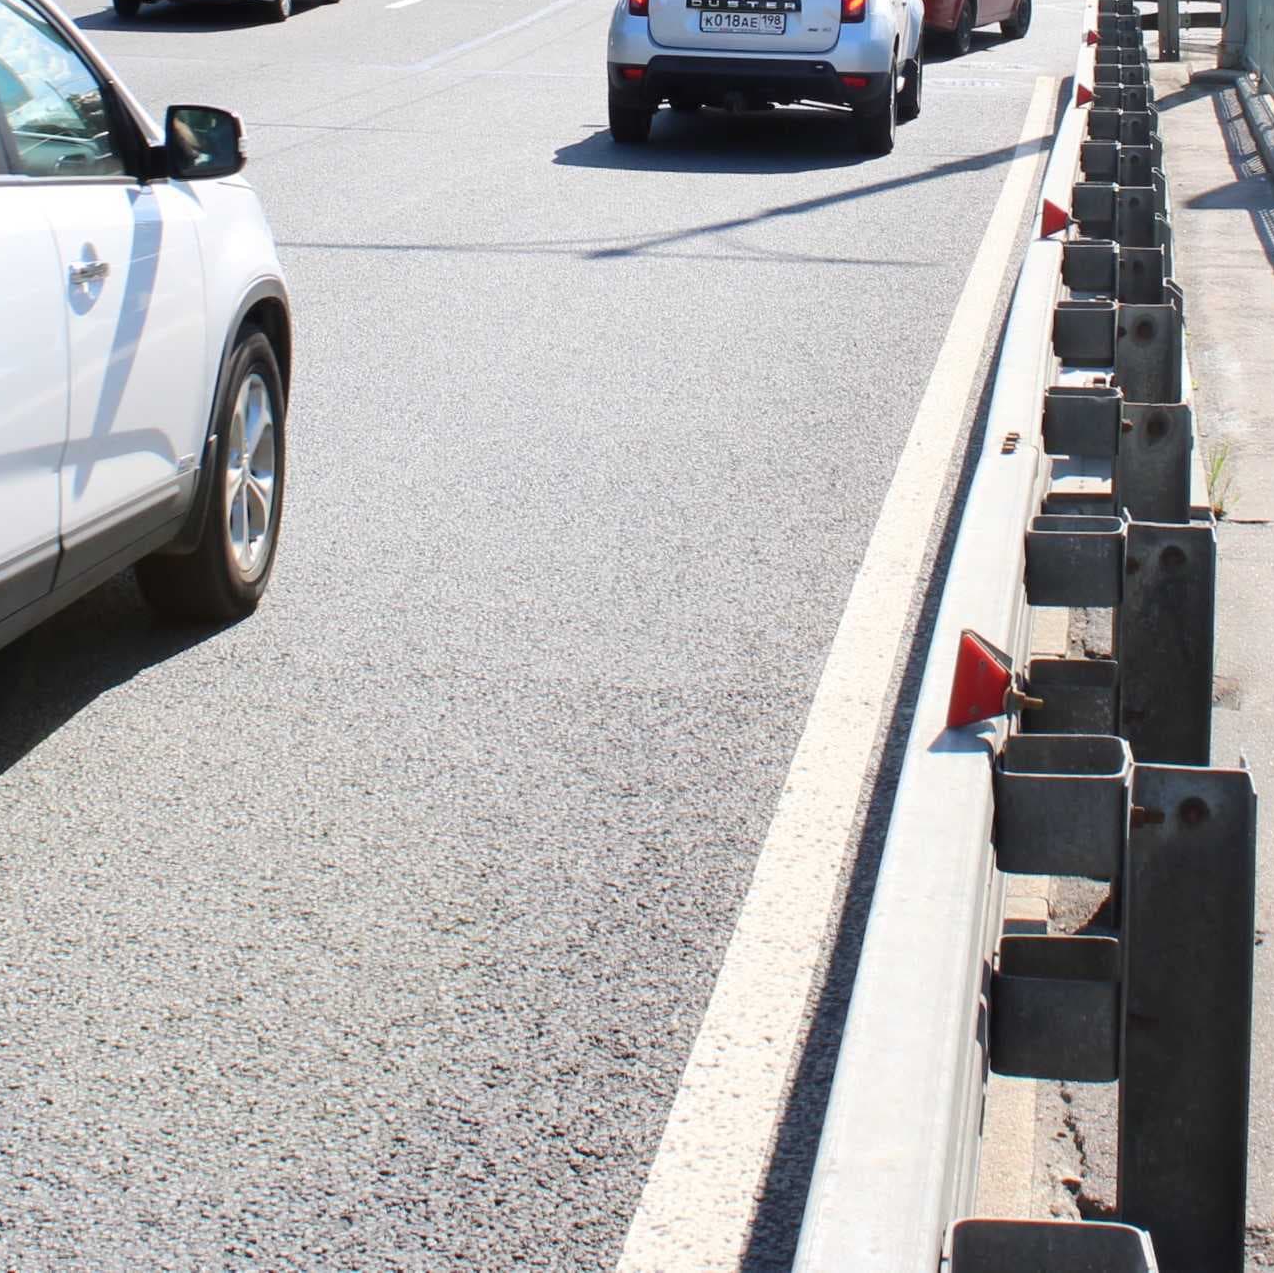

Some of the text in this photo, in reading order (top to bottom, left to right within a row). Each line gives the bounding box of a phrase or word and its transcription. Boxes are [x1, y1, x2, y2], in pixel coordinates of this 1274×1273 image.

[691, 0, 796, 10] DUSTER
[705, 14, 781, 28] К018АЕ 198
